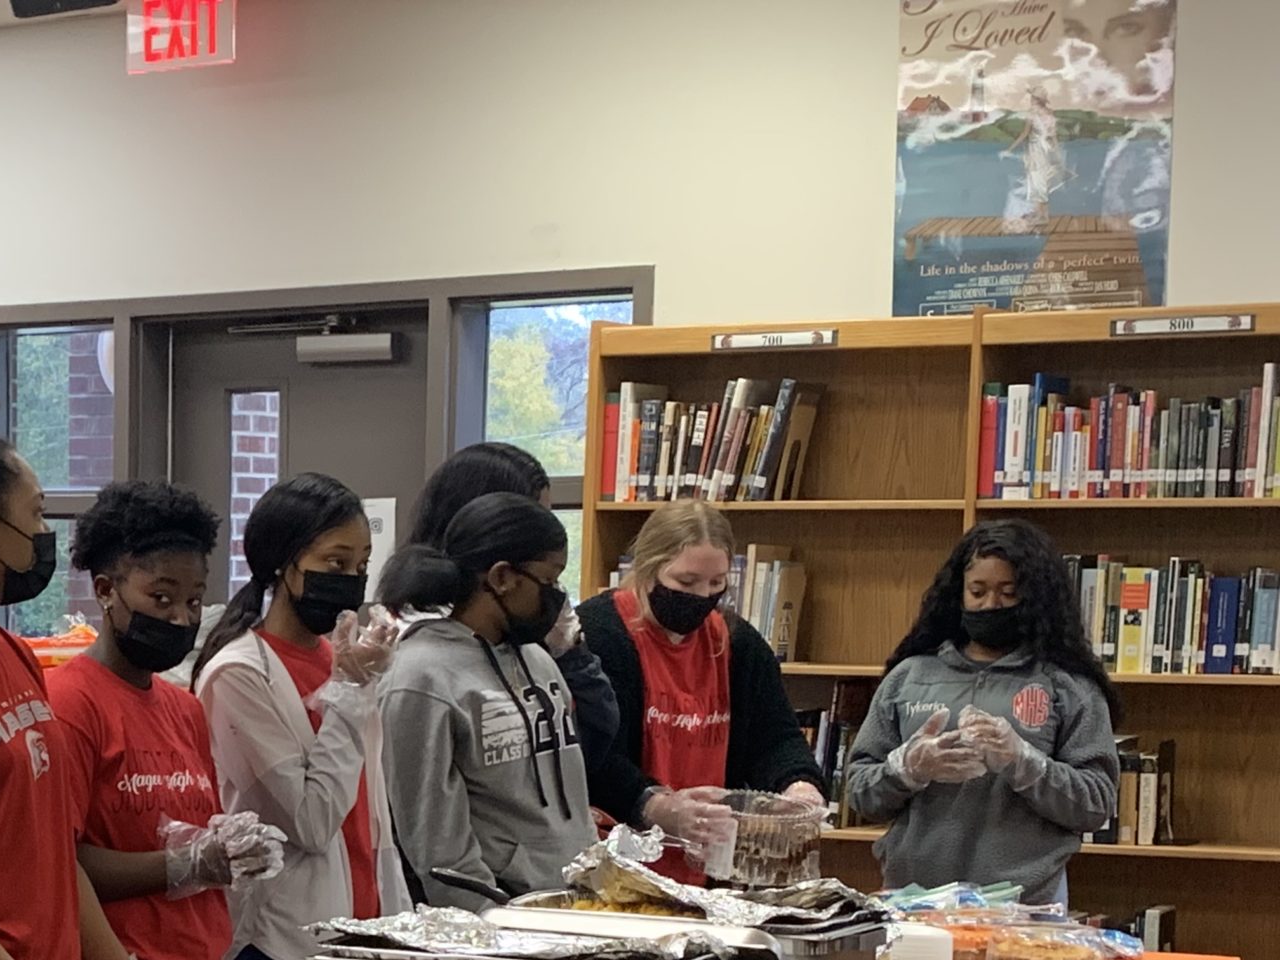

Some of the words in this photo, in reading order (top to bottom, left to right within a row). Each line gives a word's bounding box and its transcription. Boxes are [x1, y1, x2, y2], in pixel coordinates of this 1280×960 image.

[144, 0, 217, 62] EXIT
[946, 9, 1056, 50] Loved
[920, 264, 942, 277] Life
[945, 264, 956, 275] in
[960, 262, 977, 274] the
[981, 259, 1029, 273] shadows
[1169, 319, 1195, 330] 800
[761, 335, 783, 346] 700
